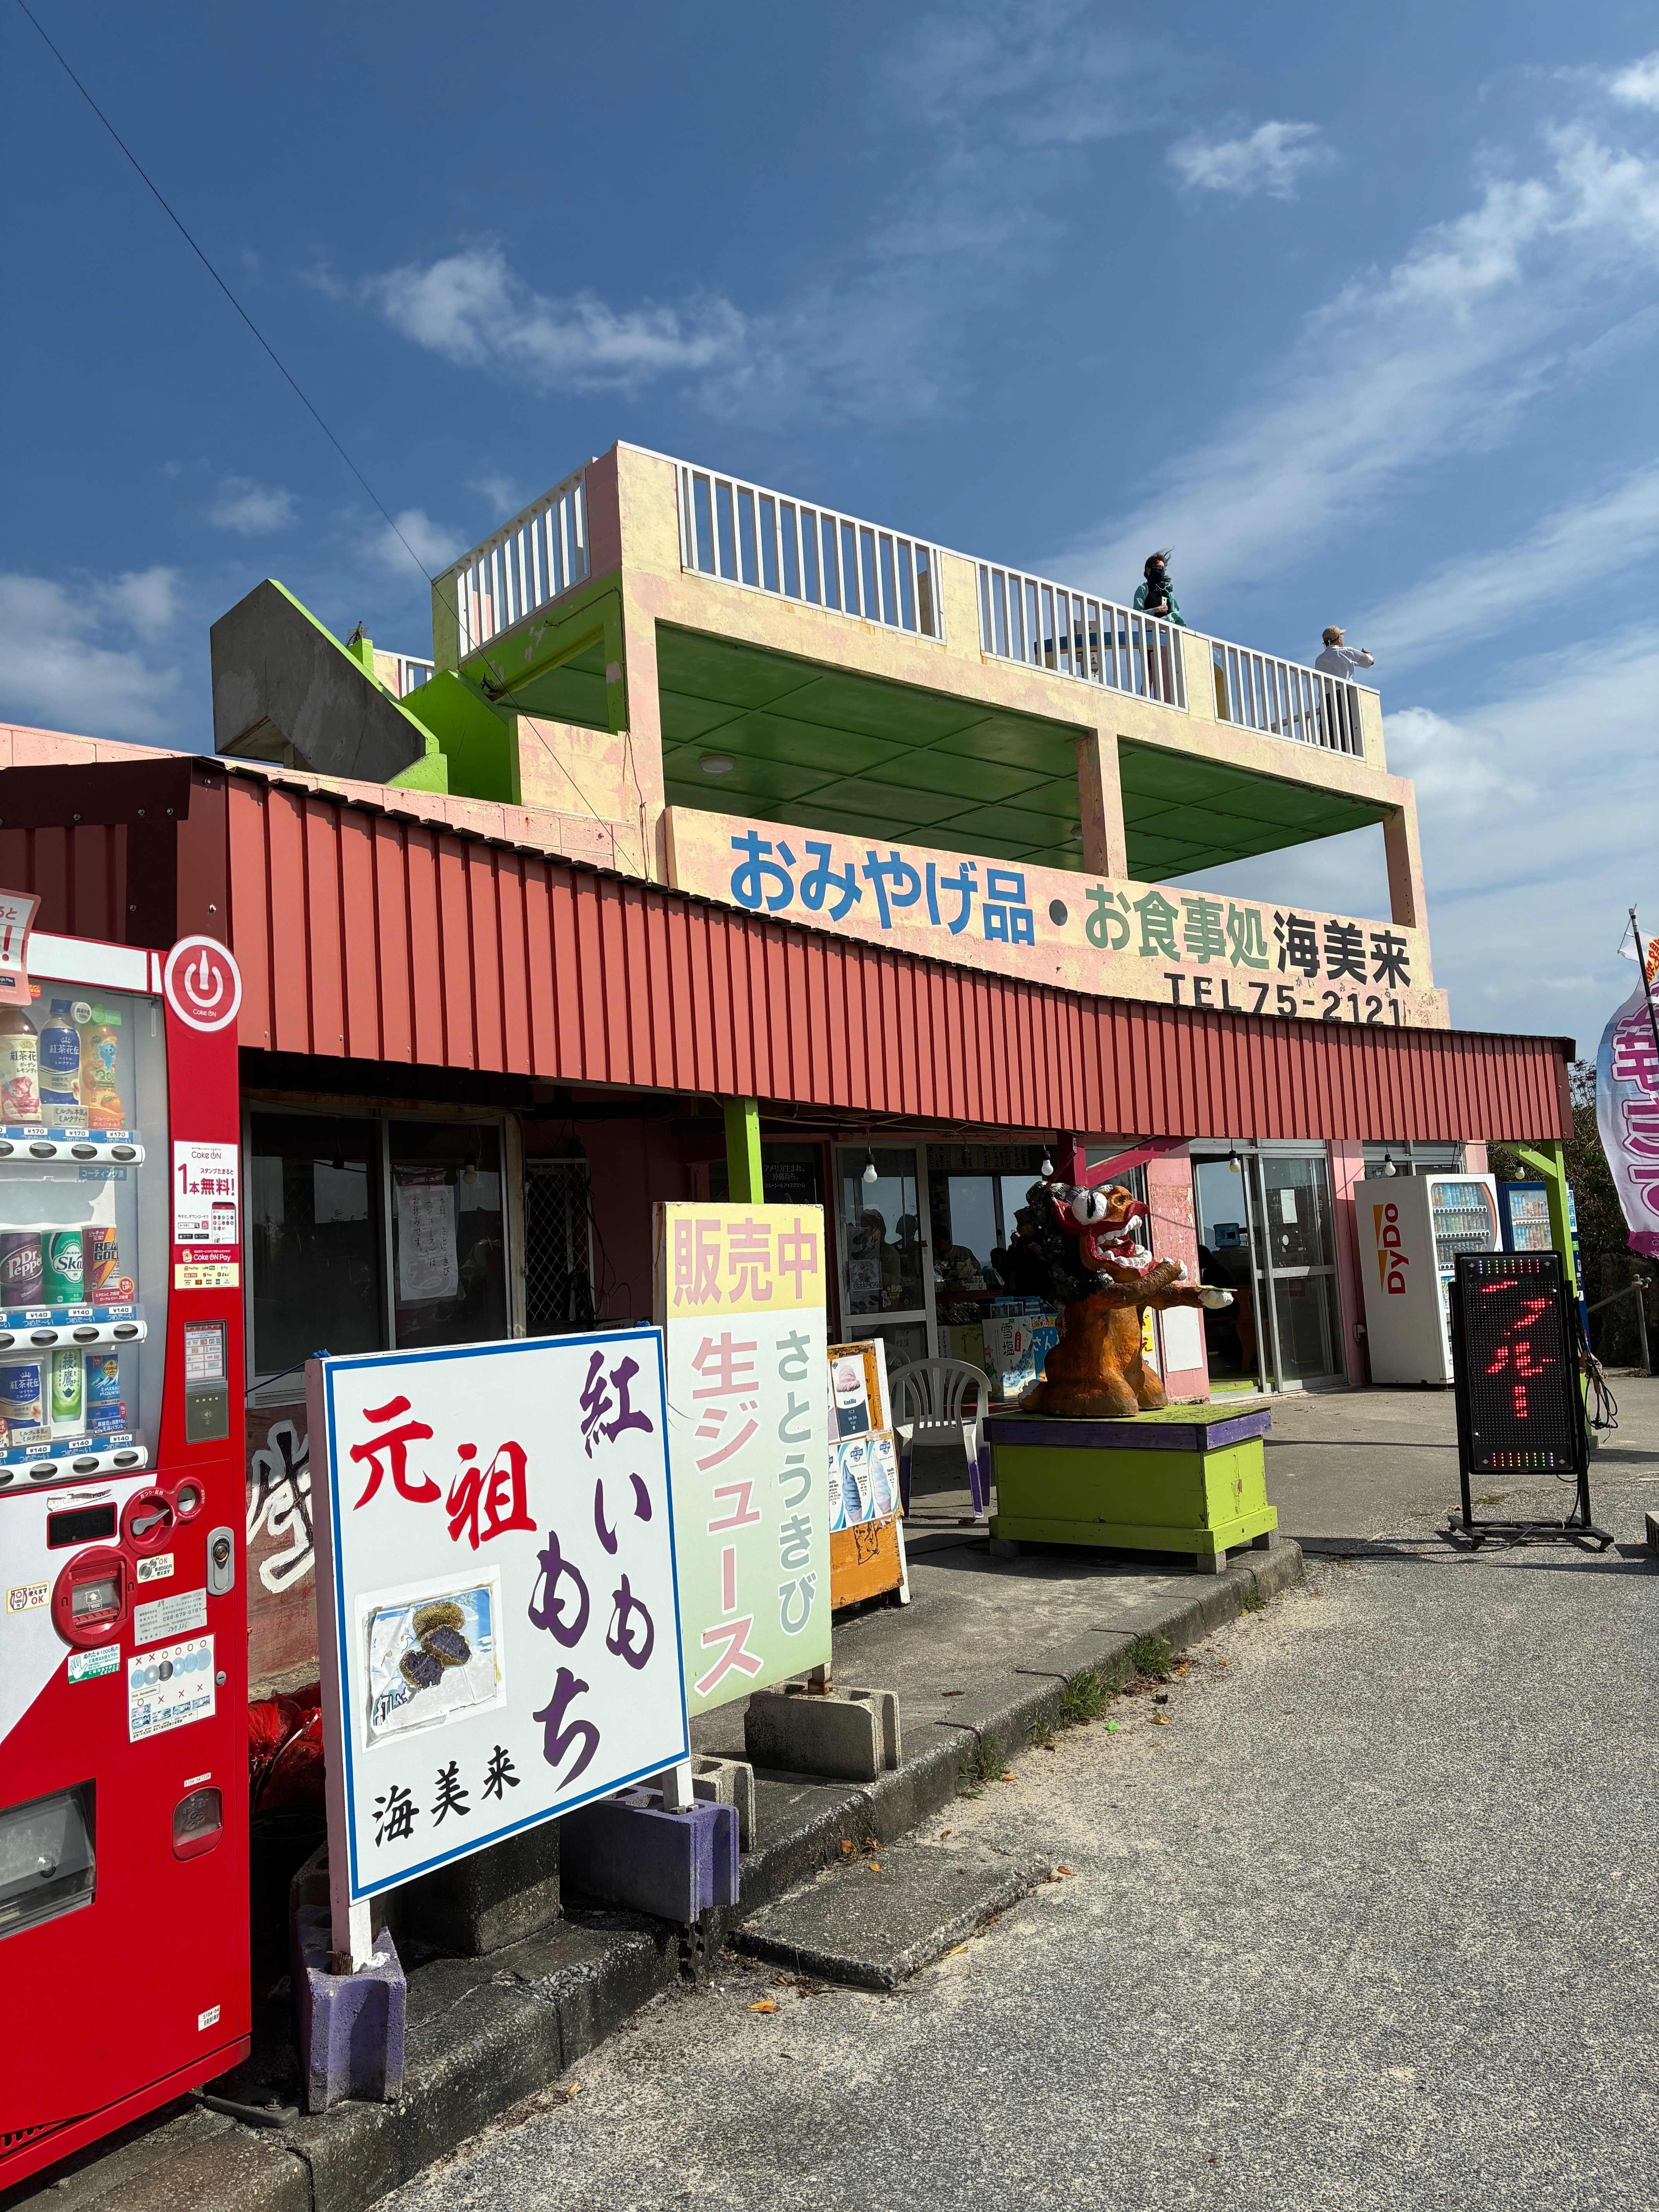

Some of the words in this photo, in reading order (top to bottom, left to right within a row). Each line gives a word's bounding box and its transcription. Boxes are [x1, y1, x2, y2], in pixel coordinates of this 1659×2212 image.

[50, 1045, 79, 1054] 紅茶花伝
[191, 1151, 210, 1159] Coke
[674, 1218, 817, 1307] 販売中
[1387, 1203, 1410, 1295] DyDo
[10, 1379, 39, 1389] 紅茶花伝
[349, 1395, 538, 1551] 元祖
[579, 1349, 655, 1671] 紅いも
[691, 1331, 766, 1698] 生ジュース
[776, 1330, 816, 1638] さとうきび
[31, 1595, 44, 1604] OK
[527, 1530, 601, 1793] もち
[371, 1745, 521, 1848] 海美来
